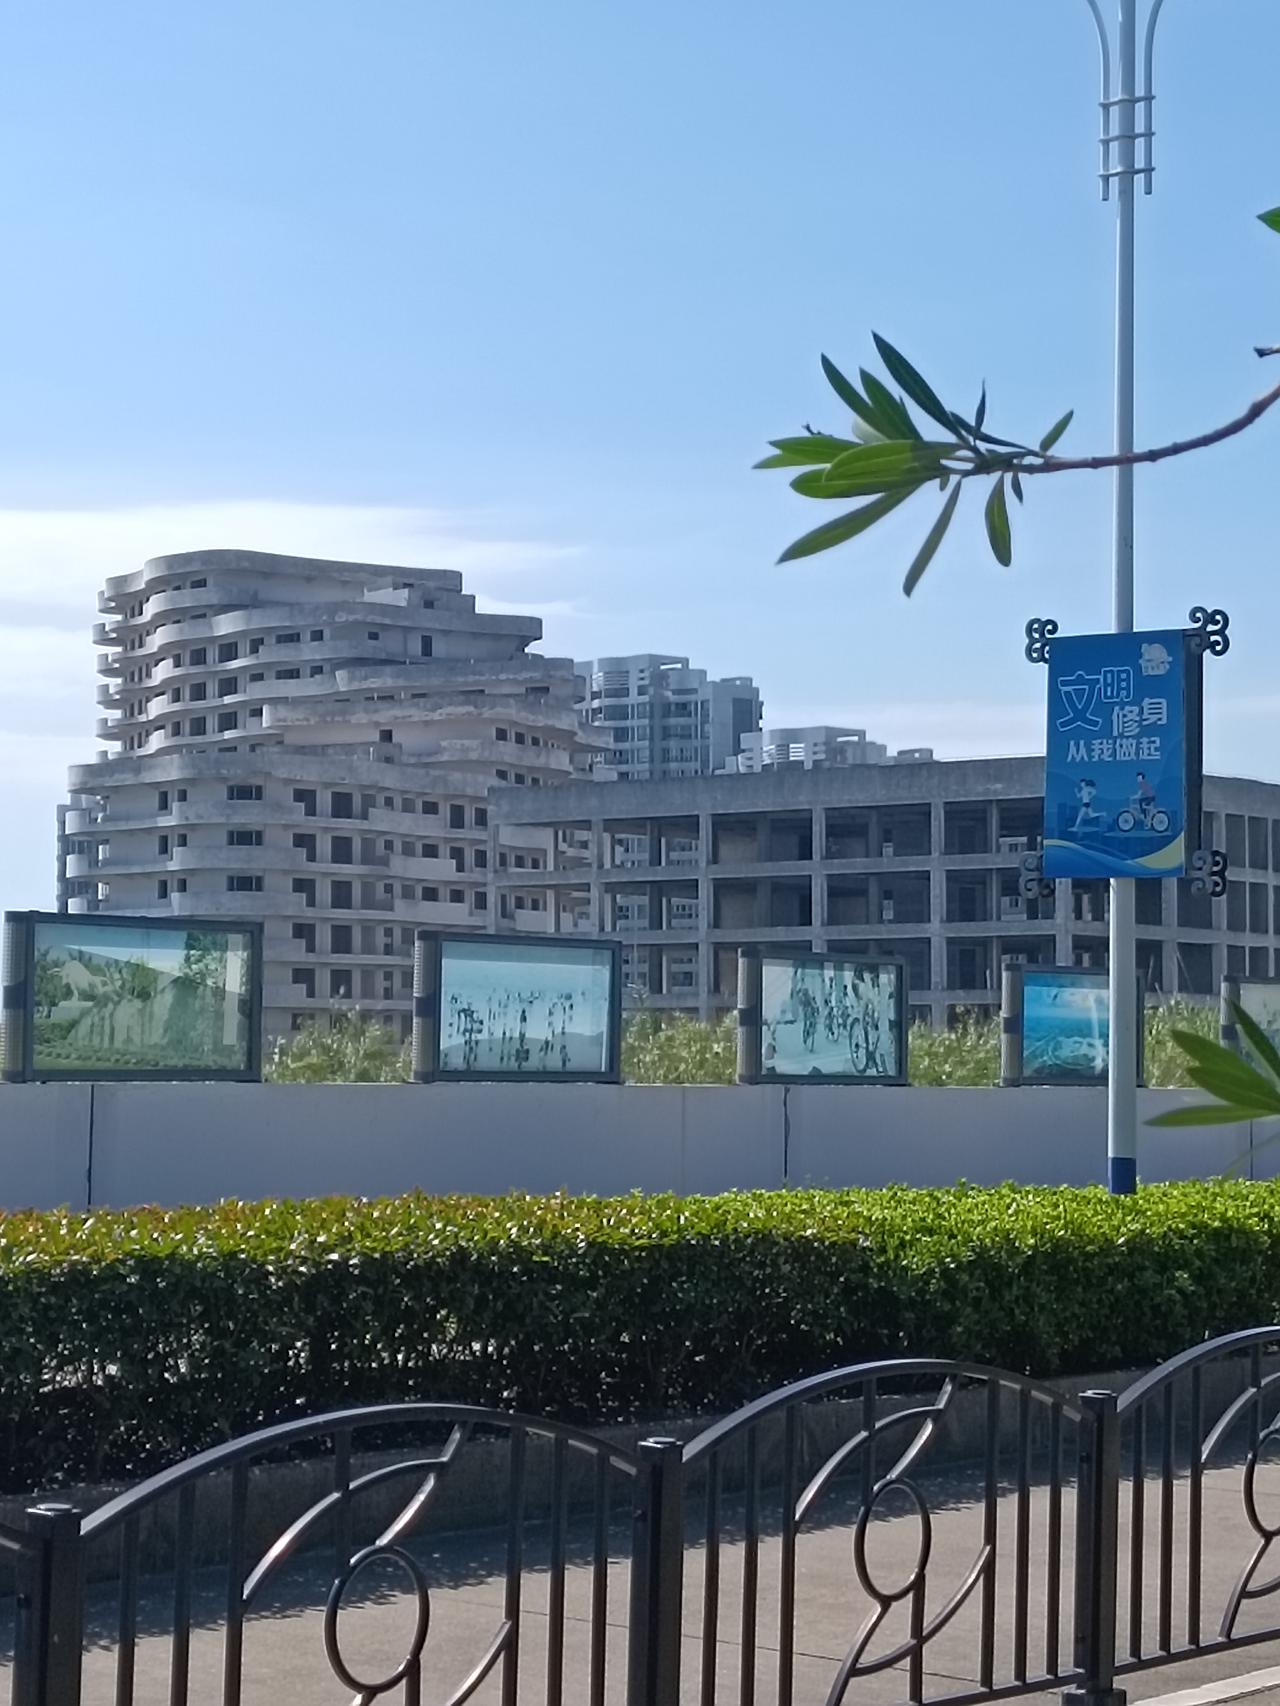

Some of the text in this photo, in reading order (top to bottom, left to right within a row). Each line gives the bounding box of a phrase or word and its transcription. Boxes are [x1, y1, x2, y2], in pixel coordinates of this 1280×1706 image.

[1057, 667, 1133, 731] 文明
[1112, 698, 1168, 736] 修身
[1068, 737, 1161, 762] 从我做起
